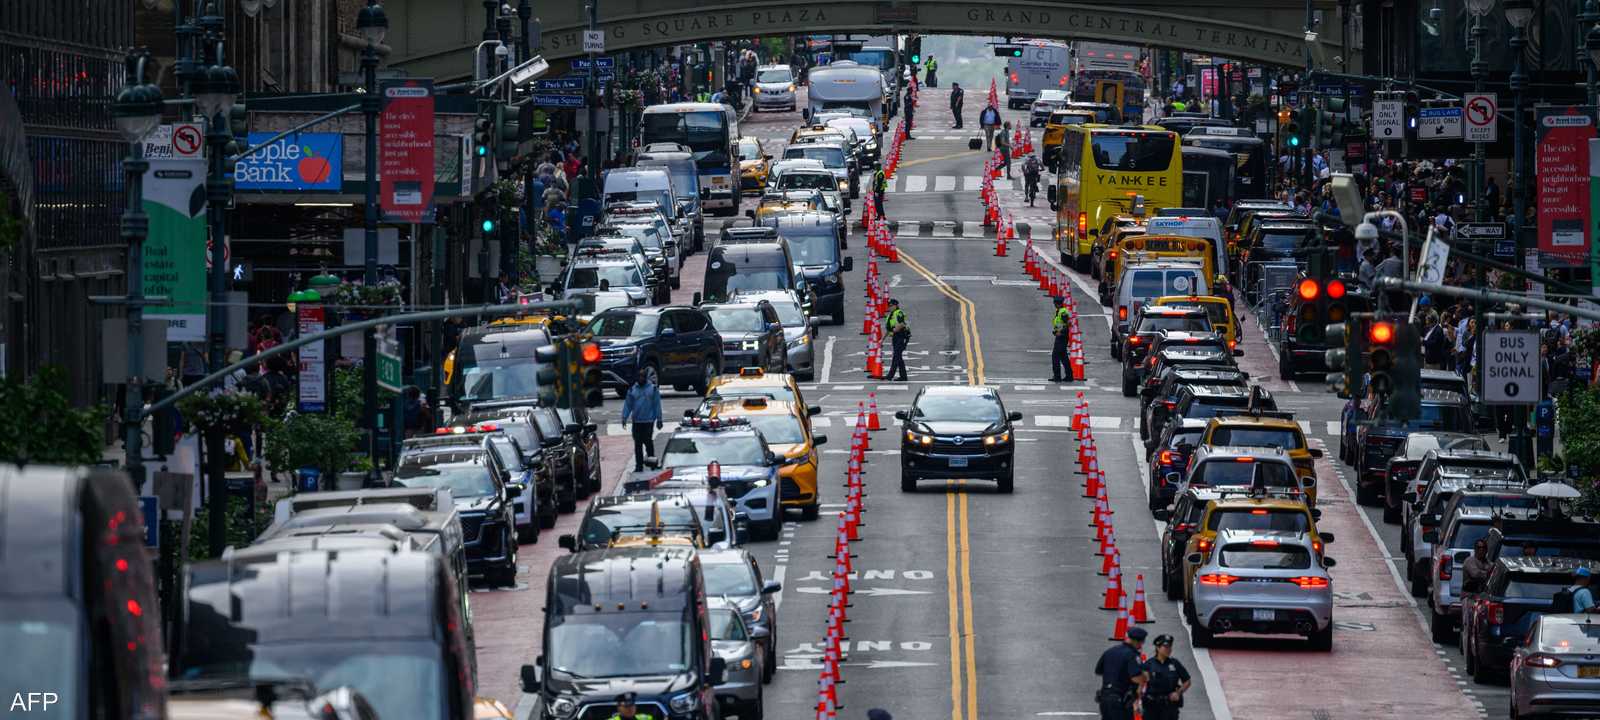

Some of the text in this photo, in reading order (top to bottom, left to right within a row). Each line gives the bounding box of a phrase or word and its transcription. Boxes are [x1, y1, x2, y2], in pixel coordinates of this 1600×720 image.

[643, 14, 735, 36] SQUARE
[752, 8, 827, 24] PLAZA
[967, 8, 1303, 56] GRAND CENTRAL TERMINA
[1543, 144, 1576, 153] The city's
[233, 162, 293, 183] Bank
[1097, 175, 1168, 186] YANKEE
[1485, 226, 1502, 235] WAY
[144, 246, 168, 256] Real
[144, 260, 175, 269] estate
[144, 272, 179, 283] capital
[1500, 337, 1525, 348] BUS
[1495, 352, 1529, 363] ONLY
[1489, 367, 1535, 378] SIGNAL
[1541, 407, 1549, 417] P
